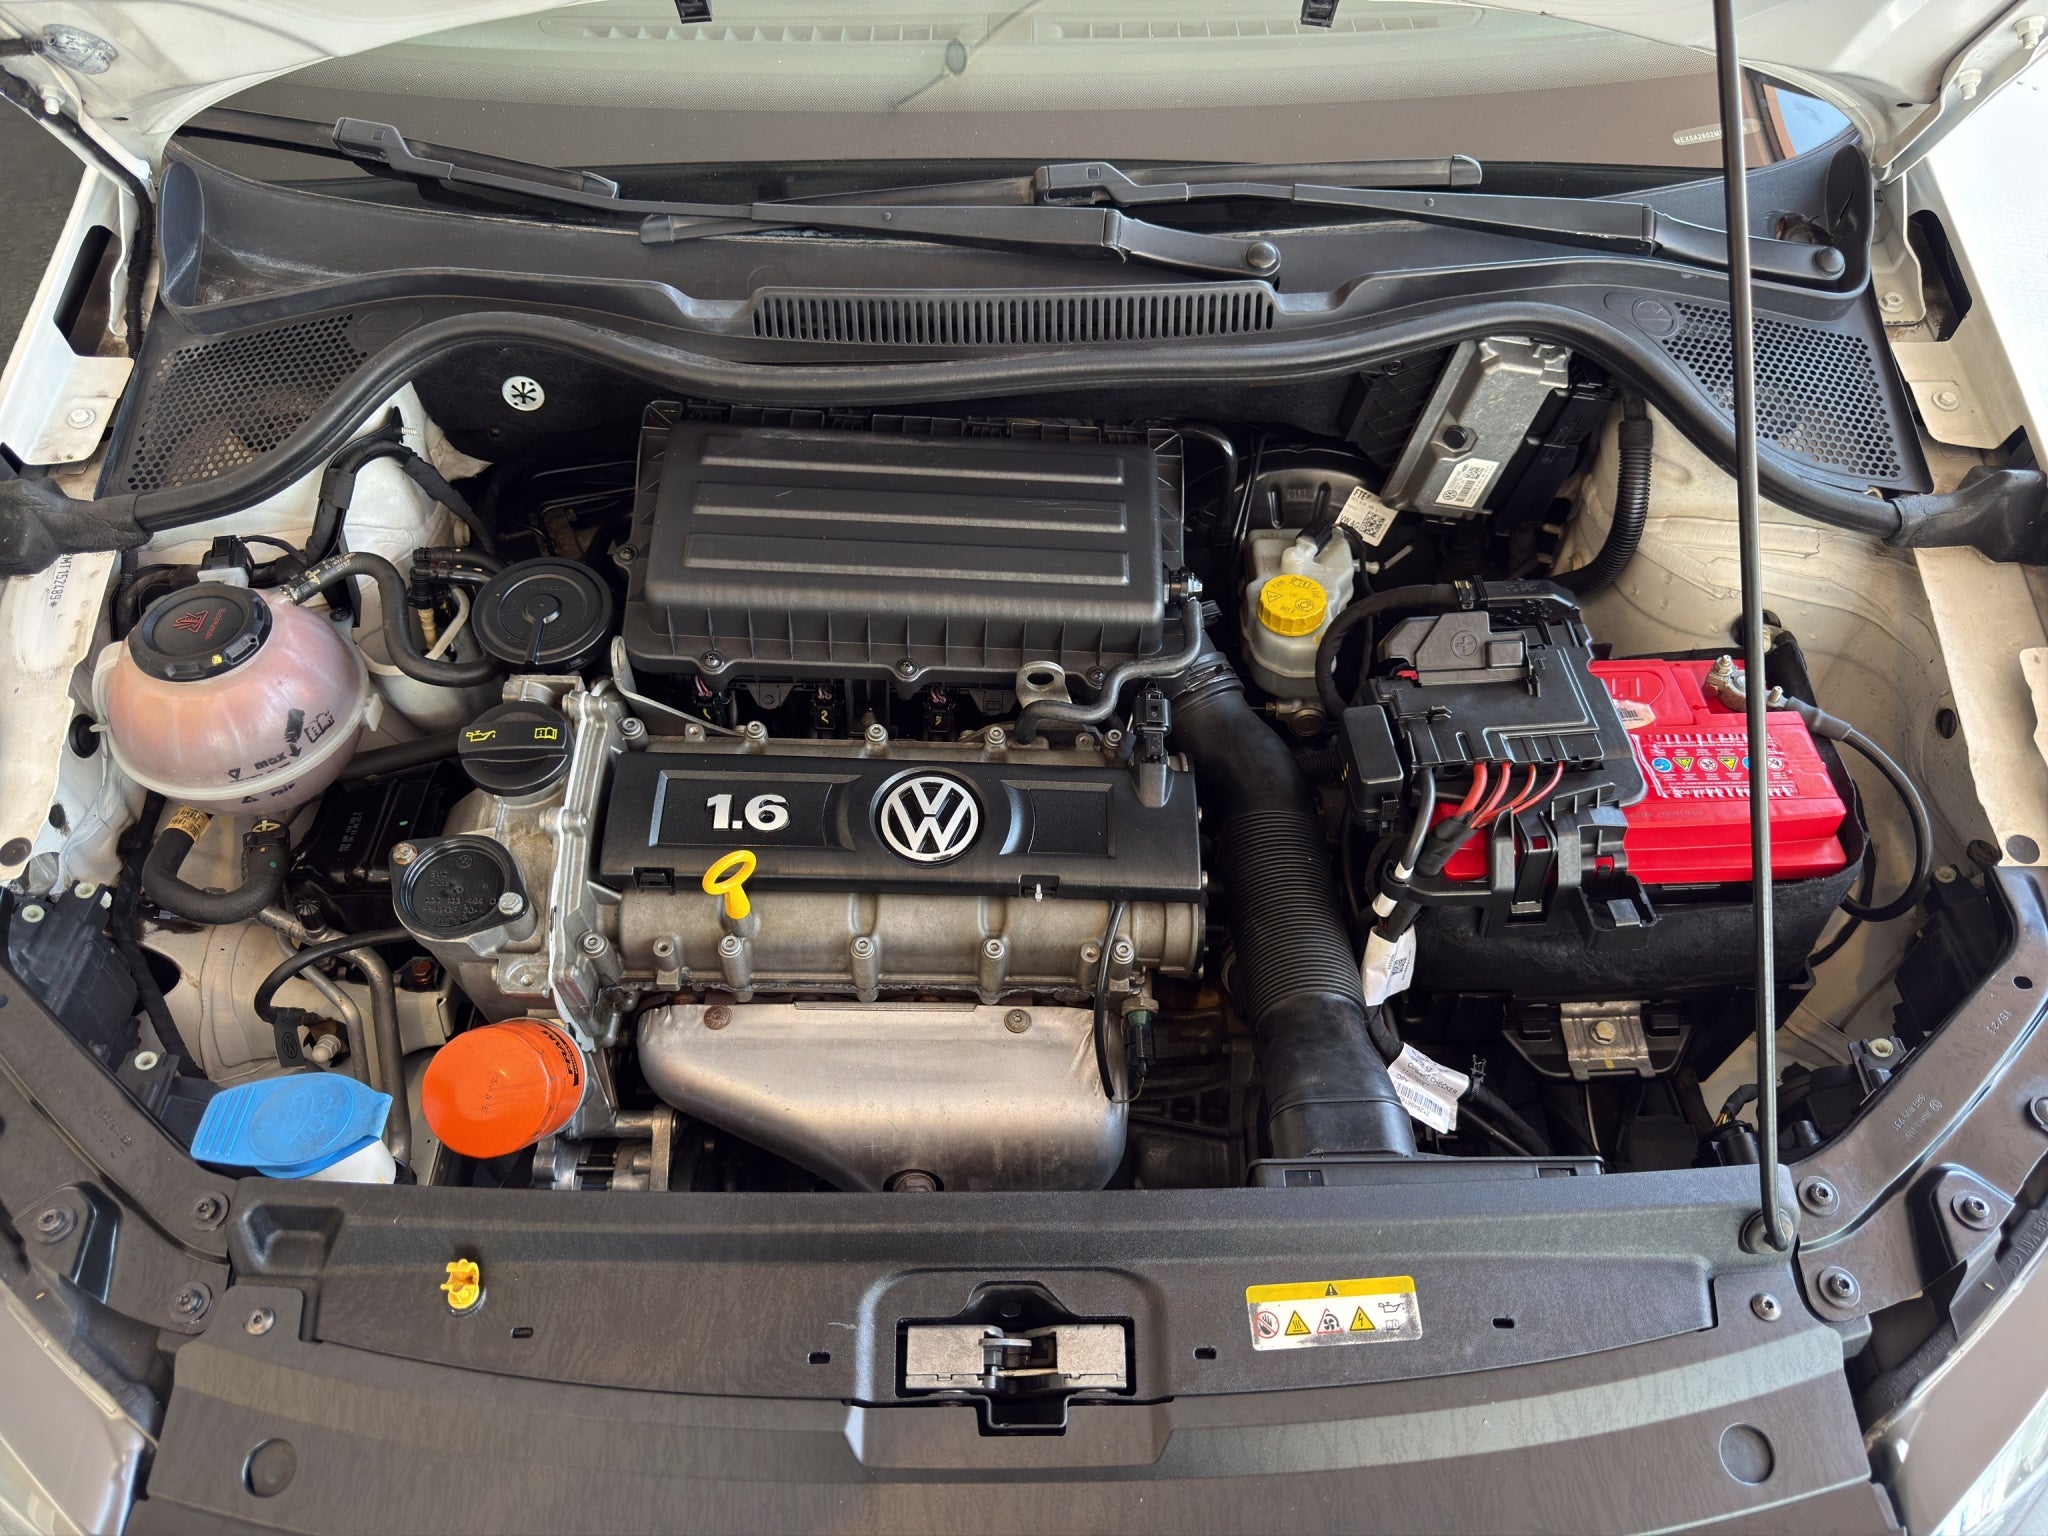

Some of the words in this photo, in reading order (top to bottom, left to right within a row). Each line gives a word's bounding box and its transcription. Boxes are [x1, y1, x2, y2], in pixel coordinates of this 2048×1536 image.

[706, 793, 792, 832] 1.6
[881, 776, 979, 862] VW
[1430, 1076, 1458, 1095] CHECKER
